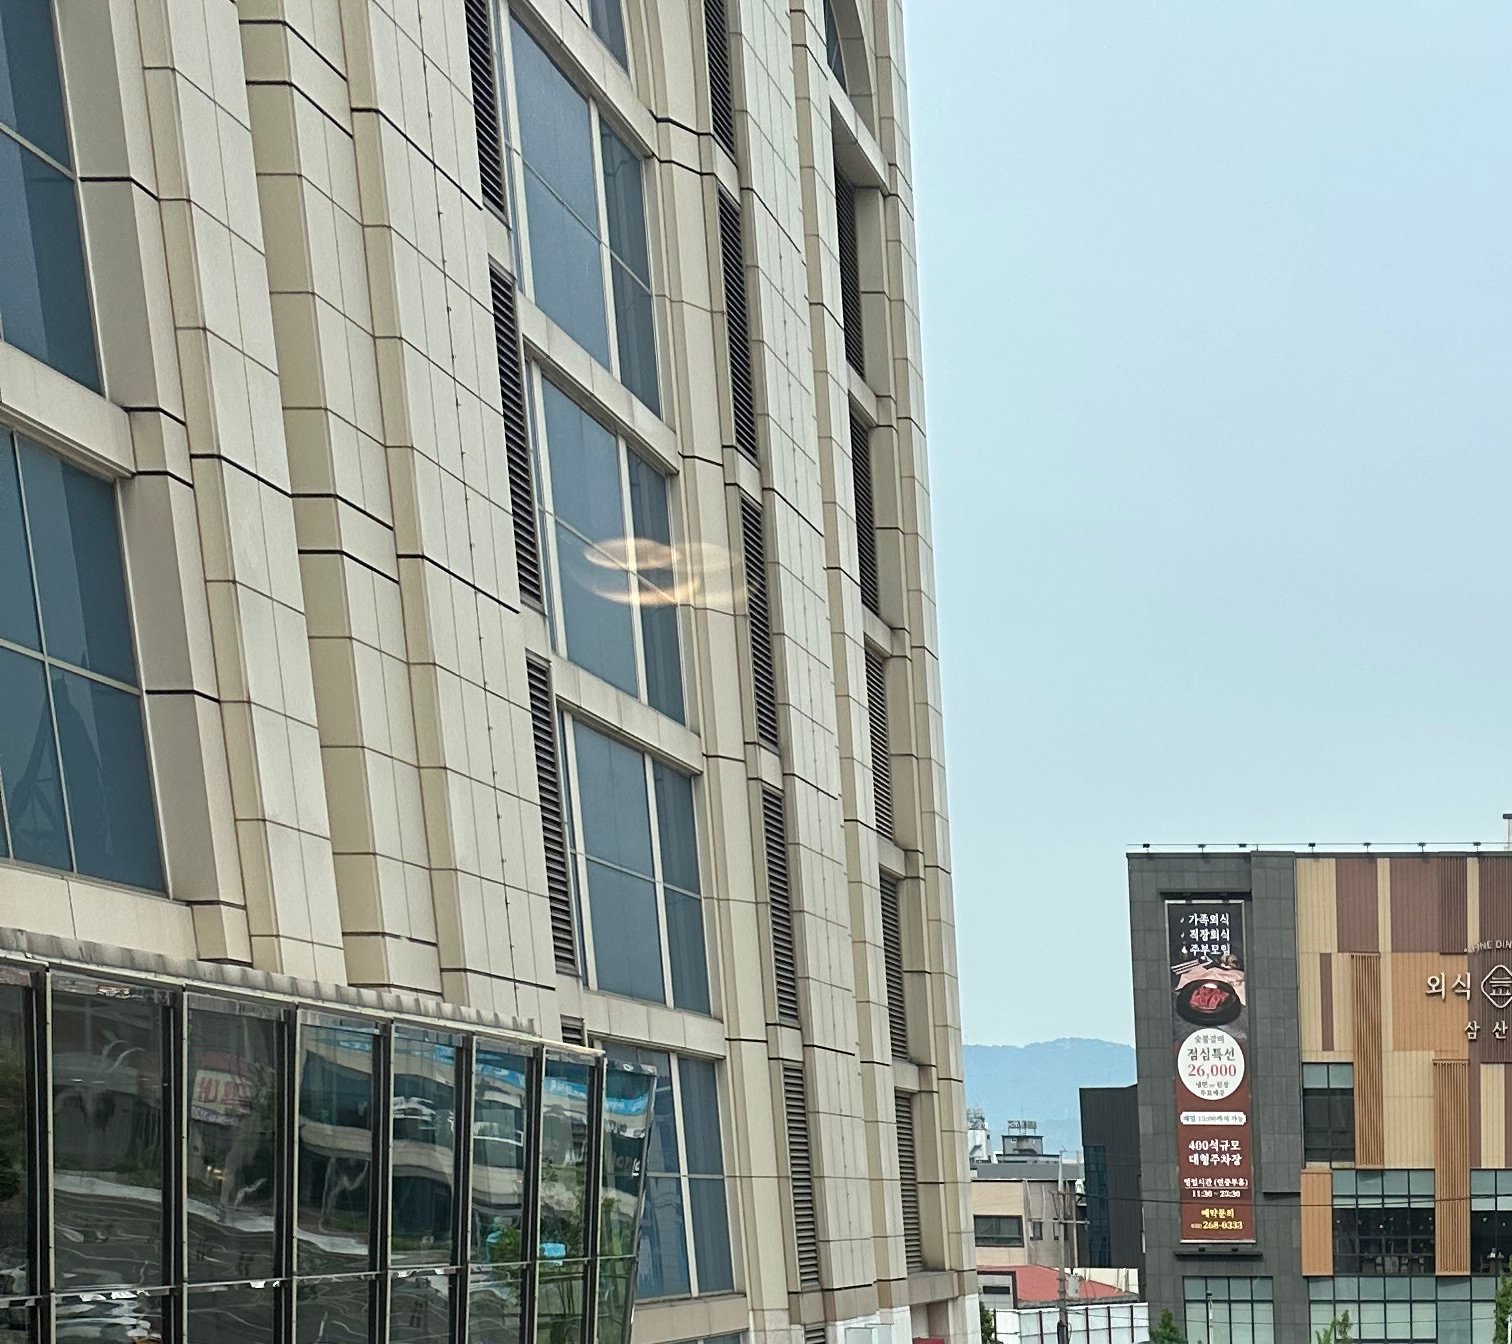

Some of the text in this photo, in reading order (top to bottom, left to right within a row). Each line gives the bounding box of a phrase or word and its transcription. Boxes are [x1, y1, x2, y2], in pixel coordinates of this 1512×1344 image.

[1188, 913, 1230, 926] 가족외식
[1189, 943, 1231, 957] 주부모임
[1425, 972, 1471, 1000] 외식
[1187, 1047, 1236, 1061] 점심특선
[1188, 1064, 1237, 1078] 26,000
[1188, 1139, 1241, 1152] 400석규모
[1188, 1153, 1242, 1166] 대형주차장
